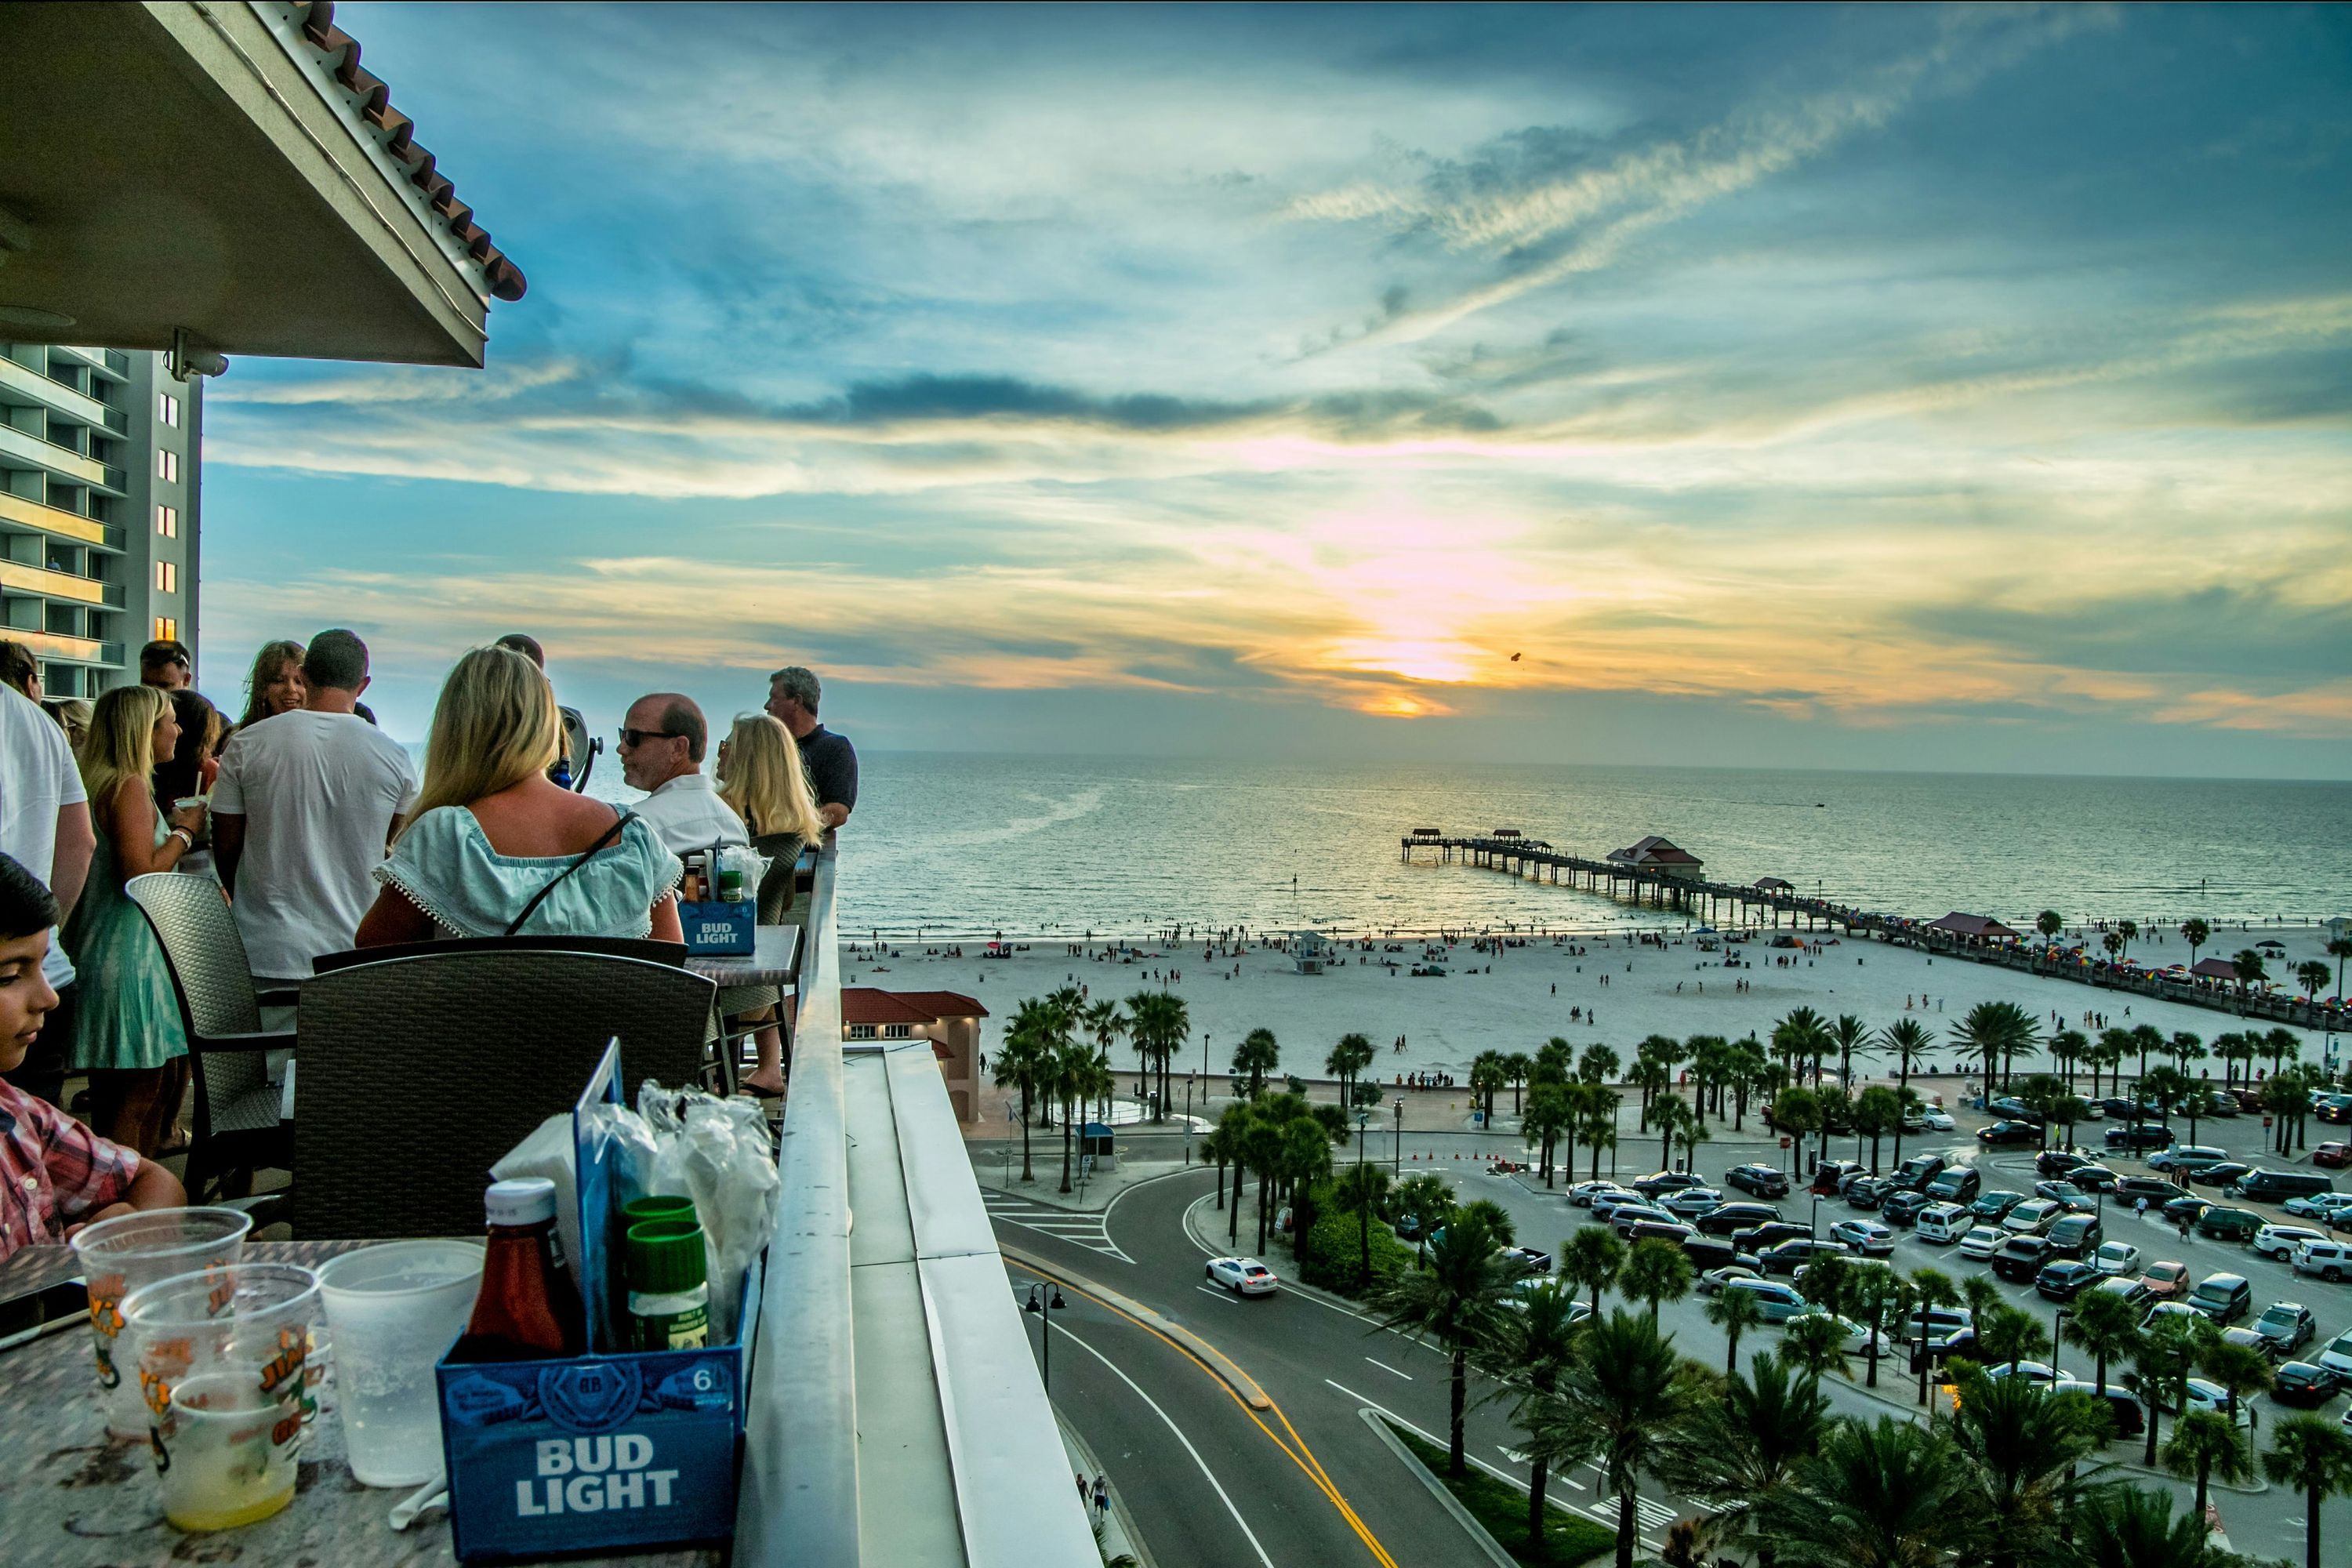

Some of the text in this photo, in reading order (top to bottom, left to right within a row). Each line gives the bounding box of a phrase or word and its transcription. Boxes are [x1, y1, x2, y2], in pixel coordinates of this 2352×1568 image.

[696, 933, 738, 944] LIGHT
[702, 923, 732, 934] BUD
[693, 1370, 712, 1391] 6
[536, 1434, 653, 1476] BUD
[516, 1470, 679, 1516] LIGHT
